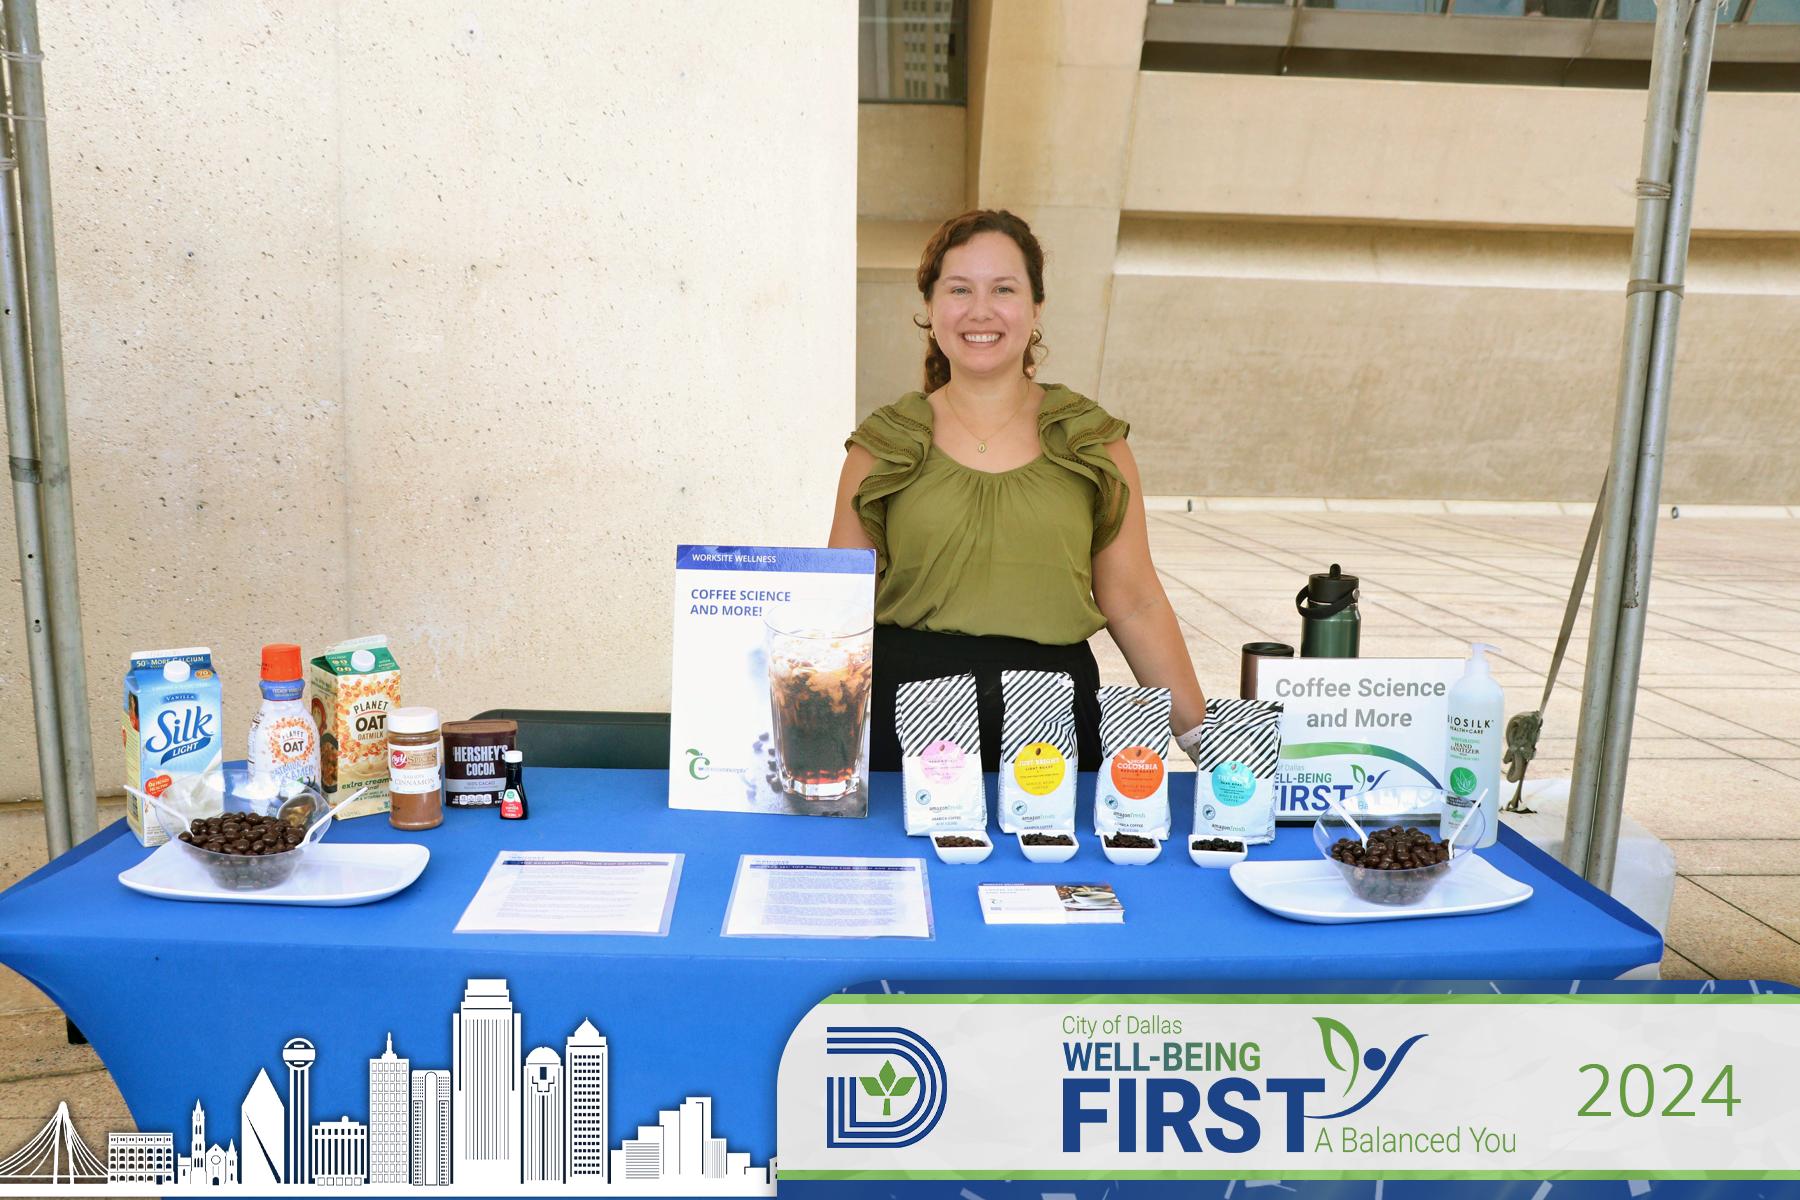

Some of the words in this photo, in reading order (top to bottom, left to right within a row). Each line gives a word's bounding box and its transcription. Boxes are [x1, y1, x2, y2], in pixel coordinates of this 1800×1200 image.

[692, 553, 733, 563] WORKSITE
[734, 554, 777, 564] WELLNESS
[691, 589, 737, 601] COFFEE
[739, 590, 791, 602] SCIENCE
[690, 604, 718, 616] AND
[721, 605, 763, 617] MORE!
[1275, 678, 1351, 699] Coffee
[1357, 677, 1447, 699] Science
[353, 700, 389, 715] PLANET
[355, 714, 387, 732] OAT
[1306, 707, 1348, 729] and
[1355, 708, 1413, 729] More
[145, 706, 214, 752] Silk
[357, 731, 384, 741] OATMILK
[172, 741, 199, 757] LIGHT
[283, 741, 304, 753] OAT
[453, 745, 509, 762] HERSHEY'S
[466, 762, 496, 776] COCOA
[1117, 762, 1158, 770] COLOMBIA
[1285, 764, 1305, 772] Dallas
[341, 781, 363, 790] extra
[364, 776, 392, 786] cream
[1275, 773, 1332, 784] ELL-BEING
[1275, 784, 1354, 812] IRST
